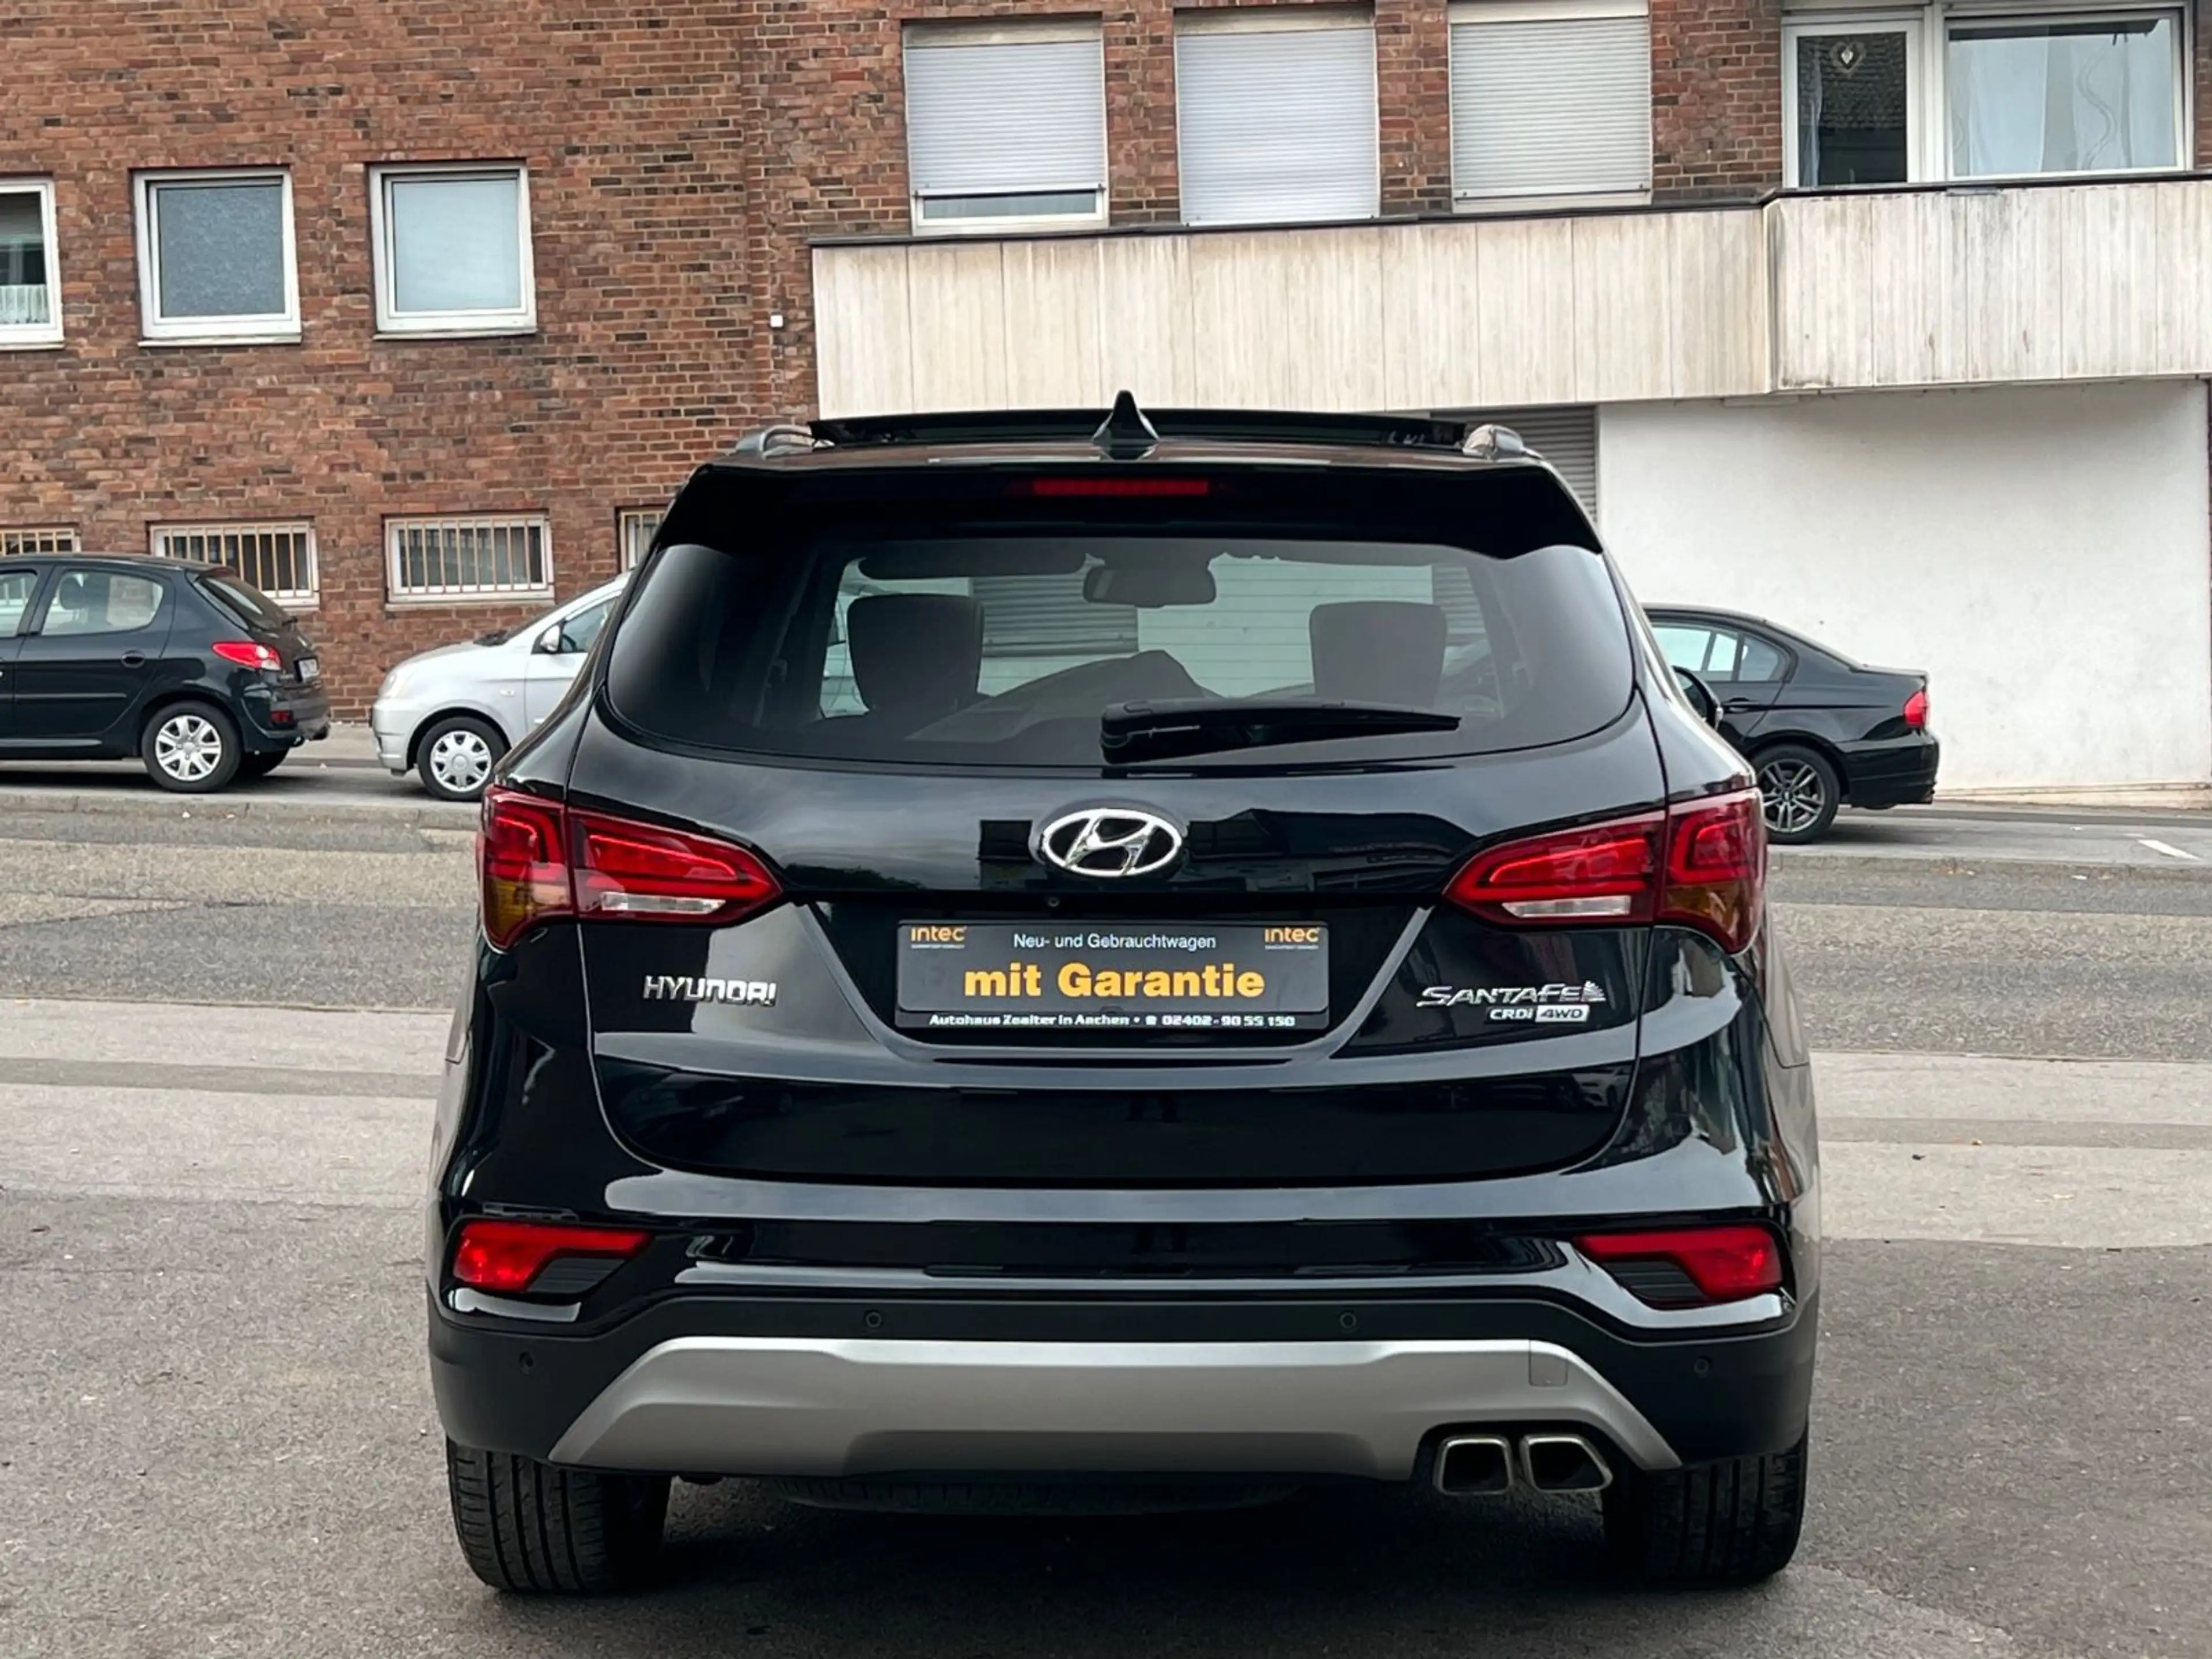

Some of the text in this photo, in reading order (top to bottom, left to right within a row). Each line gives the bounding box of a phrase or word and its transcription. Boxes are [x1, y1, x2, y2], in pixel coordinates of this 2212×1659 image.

[1014, 933, 1216, 952] Neu- und Gebrauchtwagen
[964, 963, 1265, 997] mit Garantie
[643, 975, 777, 1006] HYUNDAI
[929, 1014, 1001, 1026] Autohaus
[1058, 1014, 1073, 1026] in
[1074, 1014, 1130, 1026] Aachen
[1267, 1016, 1296, 1027] 150
[1540, 1008, 1584, 1020] 4WD
